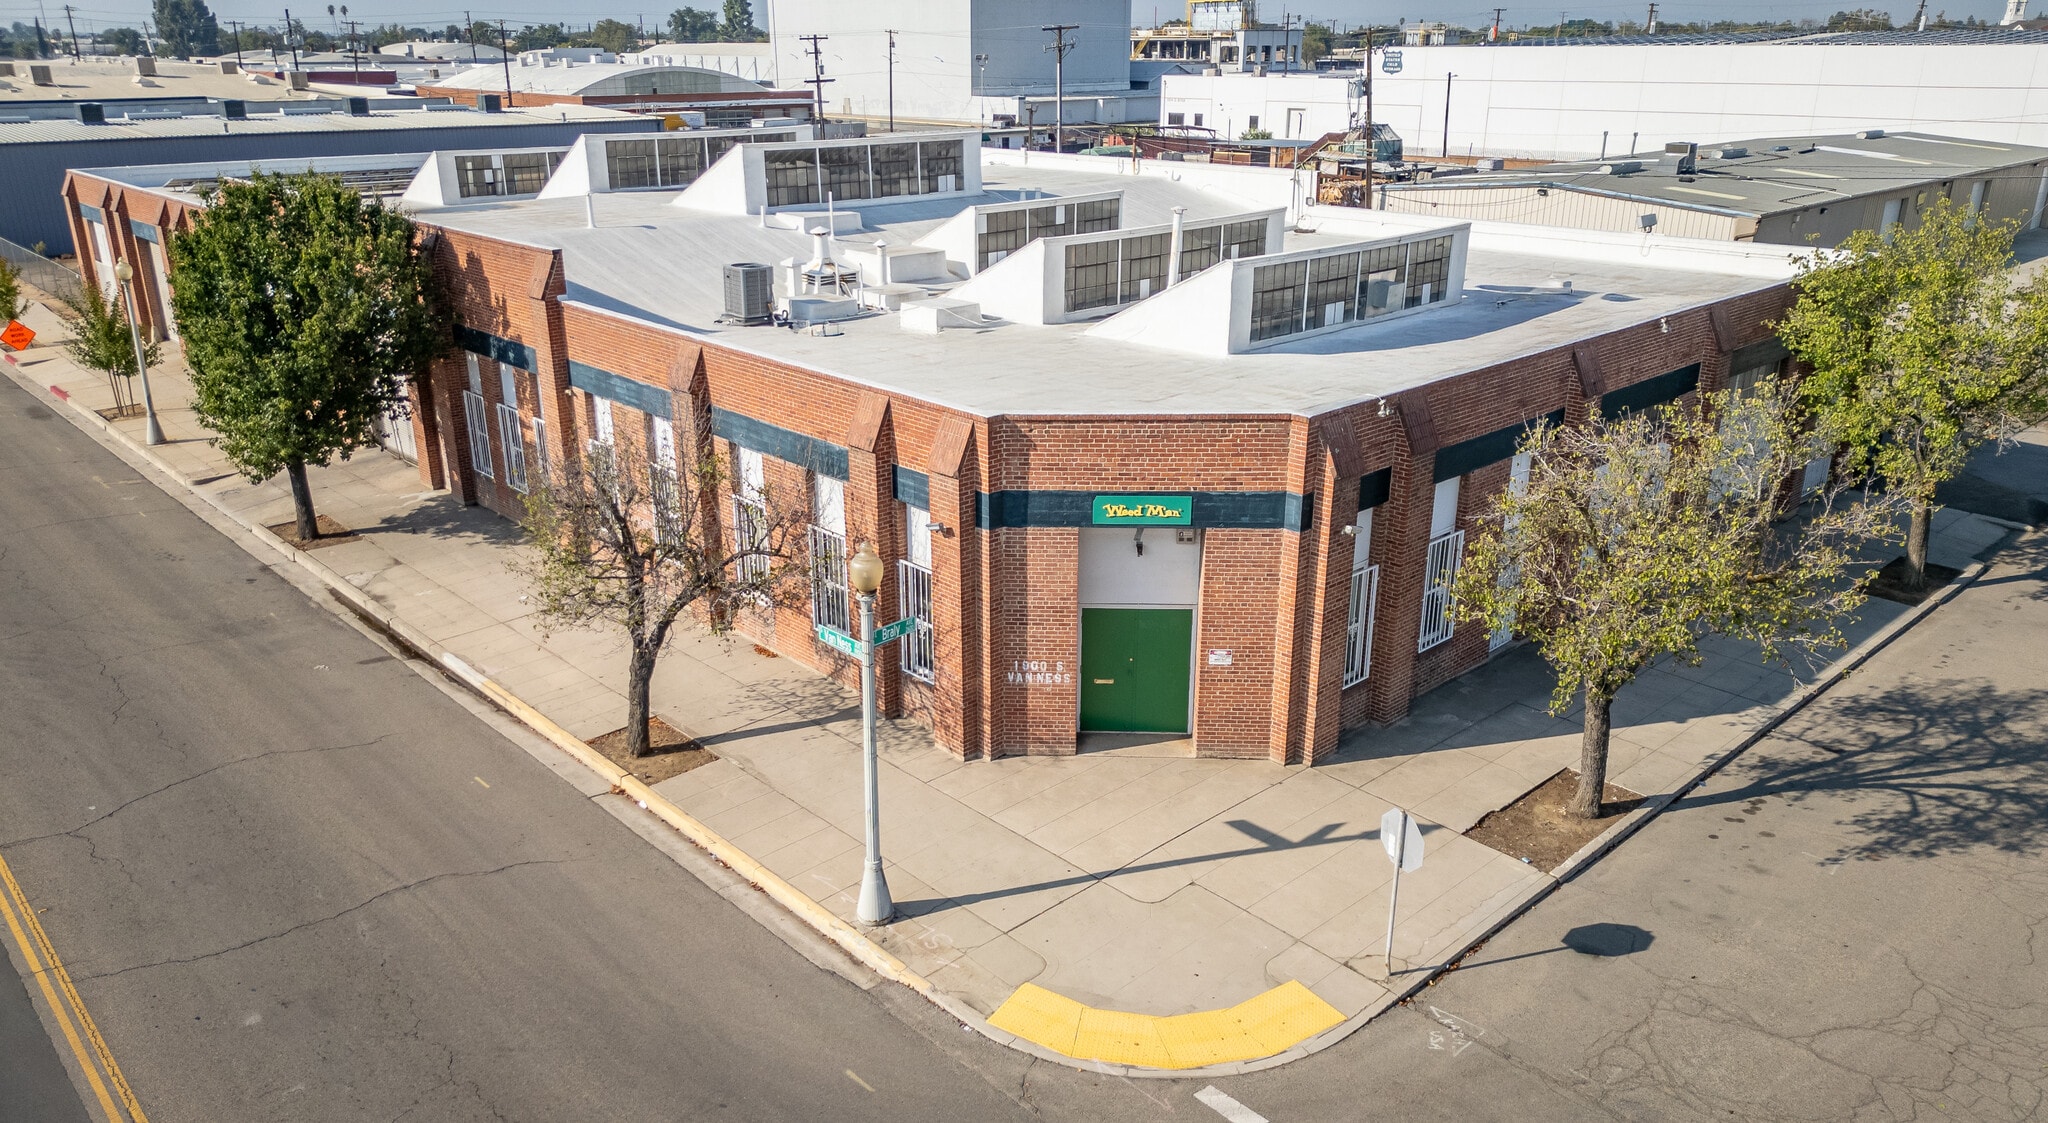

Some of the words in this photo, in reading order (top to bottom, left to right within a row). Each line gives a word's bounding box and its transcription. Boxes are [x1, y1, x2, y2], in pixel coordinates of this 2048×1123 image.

[1102, 503, 1144, 518] Weed
[1145, 504, 1181, 518] Man
[882, 623, 901, 640] Braly
[824, 628, 836, 644] Van
[837, 634, 852, 653] Ness
[1014, 660, 1047, 671] 1900
[1056, 661, 1064, 671] S
